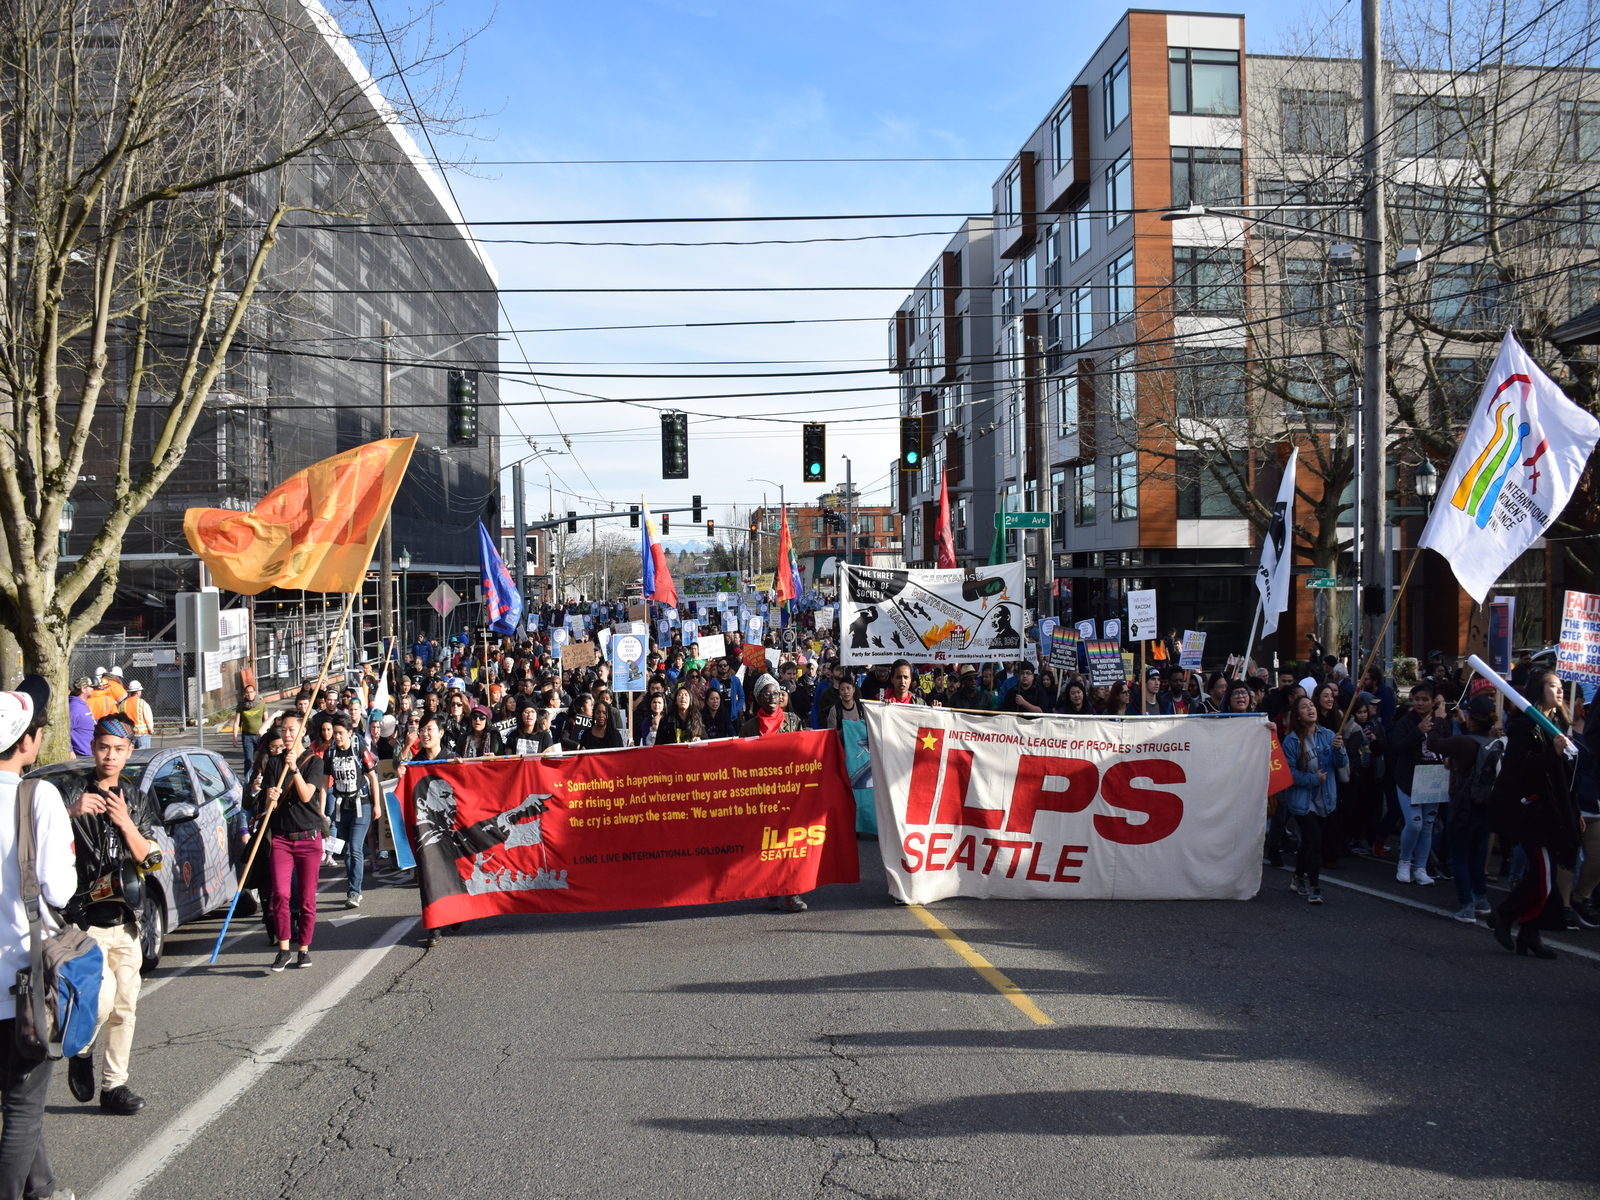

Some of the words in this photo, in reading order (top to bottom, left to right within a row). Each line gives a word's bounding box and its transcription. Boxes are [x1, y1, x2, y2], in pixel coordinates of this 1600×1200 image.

[1498, 491, 1527, 522] WOMEN'S
[1504, 480, 1550, 528] INTERNATIONAL
[858, 570, 871, 578] THE
[873, 571, 894, 579] THREE
[921, 572, 984, 582] CAPITALISM
[858, 580, 876, 588] EVILS
[856, 590, 886, 599] SOCIETY
[911, 587, 963, 622] MILITARISM
[1566, 609, 1574, 618] IS
[1577, 610, 1600, 621] TAKIN
[887, 606, 917, 645] RACISM
[1564, 619, 1579, 629] THE
[1583, 622, 1600, 632] FIRS
[1053, 627, 1079, 646] NO!
[1562, 630, 1582, 640] STEP
[1584, 632, 1600, 642] EVE
[934, 651, 946, 660] PSL
[1087, 640, 1120, 658] NO!
[1560, 641, 1584, 652] WHEN
[1560, 651, 1584, 661] CANT
[1557, 660, 1574, 671] THE
[949, 730, 1025, 746] INTERNATIONAL
[1027, 736, 1068, 749] LEAGUE
[1071, 739, 1084, 750] OF
[1086, 741, 1134, 754] PEOPLES'
[1136, 742, 1190, 753] STRUGGLE
[335, 769, 356, 780] LIVES
[567, 778, 614, 792] Something
[616, 776, 624, 788] is
[627, 772, 673, 787] happening
[675, 772, 683, 782] in
[686, 773, 700, 782] our
[702, 768, 730, 781] world.
[732, 767, 747, 778] The
[749, 766, 782, 777] masses
[785, 762, 794, 775] of
[795, 759, 822, 776] people
[569, 800, 583, 809] are
[586, 796, 611, 810] rising
[614, 797, 628, 809] up.
[630, 792, 646, 804] And
[649, 791, 690, 802] wherever
[692, 789, 710, 802] they
[713, 790, 727, 799] are
[730, 782, 777, 798] assembled
[778, 780, 801, 795] today
[906, 727, 1186, 845] ILPS
[569, 817, 584, 827] the
[587, 816, 601, 828] cry
[603, 814, 611, 825] is
[614, 813, 644, 824] always
[646, 810, 660, 821] the
[662, 811, 688, 820] same:
[710, 805, 732, 817] want
[734, 804, 743, 815] to
[746, 803, 757, 815] be
[762, 825, 826, 850] ILPS
[574, 855, 598, 864] LONG
[600, 853, 620, 863] LIVE
[622, 848, 691, 861] INTERNATIONAL
[695, 844, 745, 856] SOLIDARITY
[761, 846, 807, 861] SEATTLE
[901, 831, 1088, 883] SEATTLE
